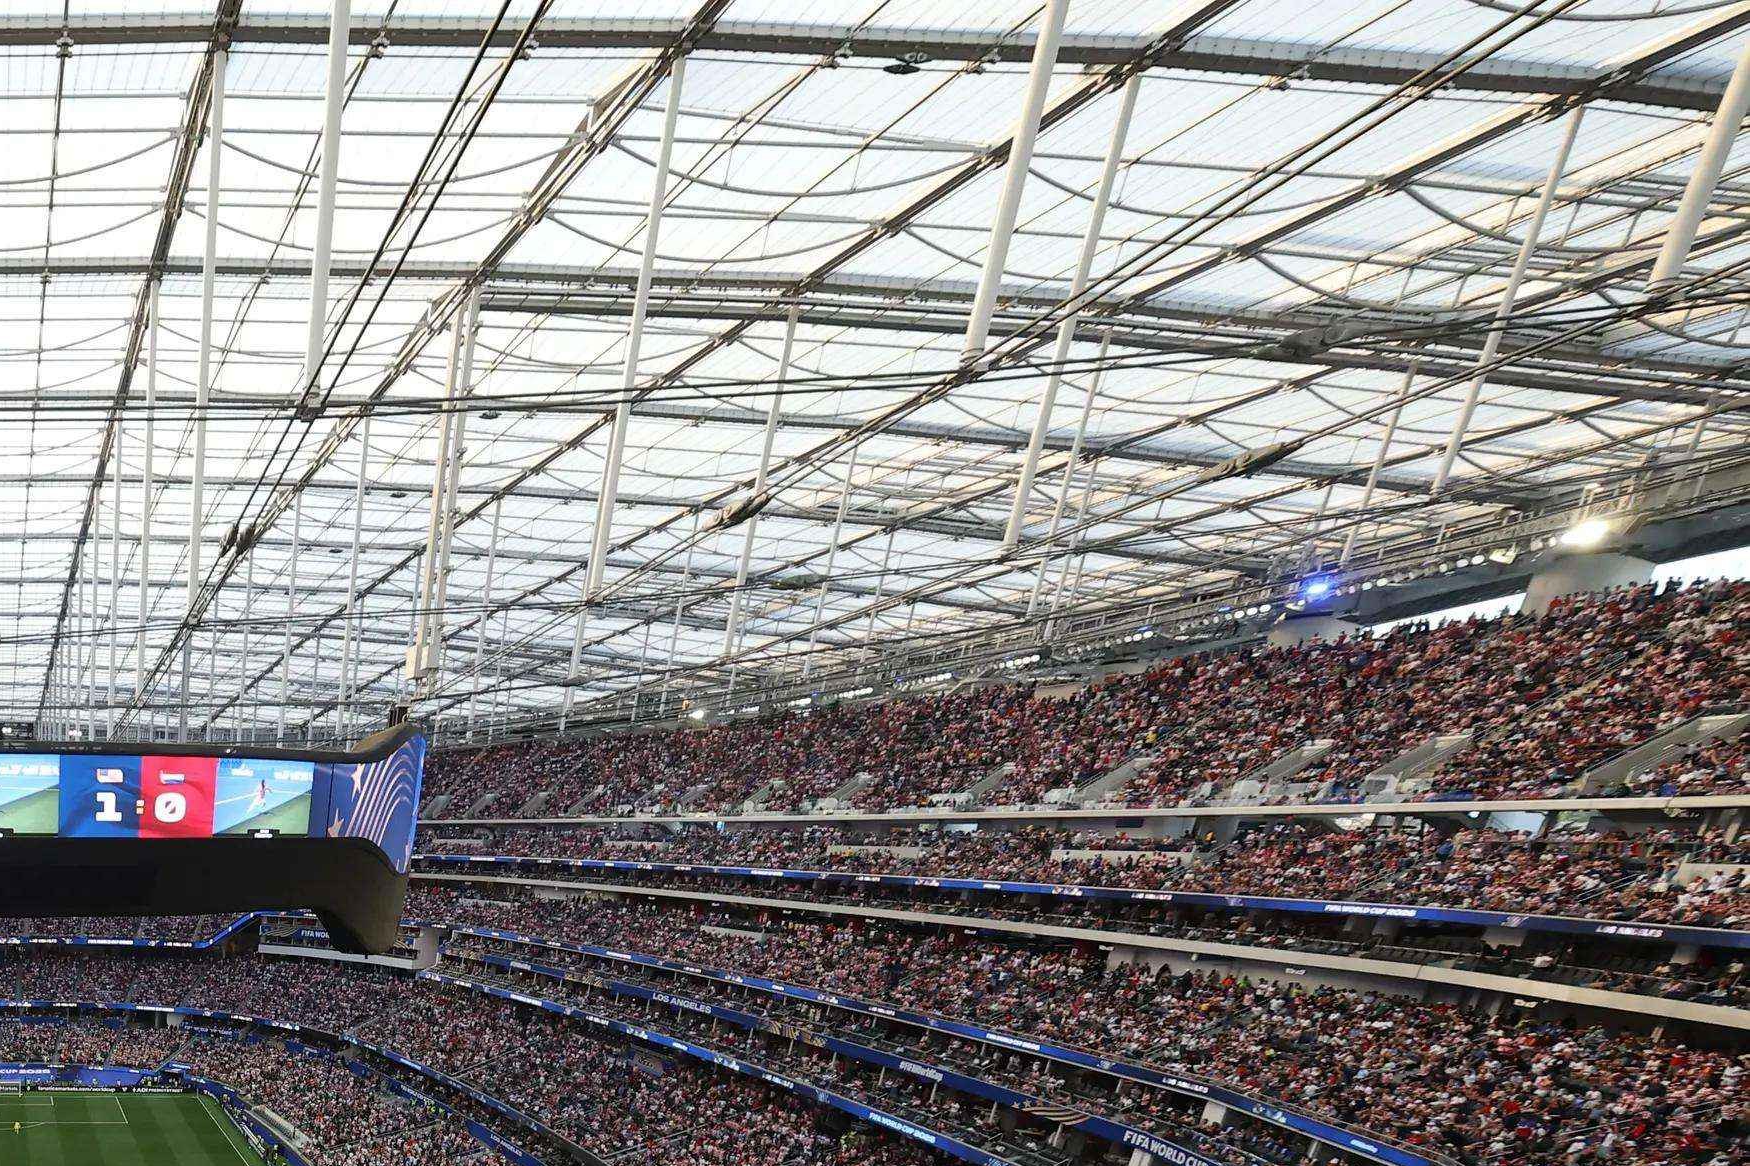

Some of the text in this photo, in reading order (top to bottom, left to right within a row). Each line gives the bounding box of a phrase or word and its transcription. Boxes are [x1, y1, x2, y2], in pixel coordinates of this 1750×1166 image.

[95, 792, 122, 822] 1
[154, 792, 186, 823] 0
[652, 992, 712, 1015] LOS ANGELES
[1123, 1130, 1151, 1150] FIFA
[1150, 1136, 1186, 1166] WORLD
